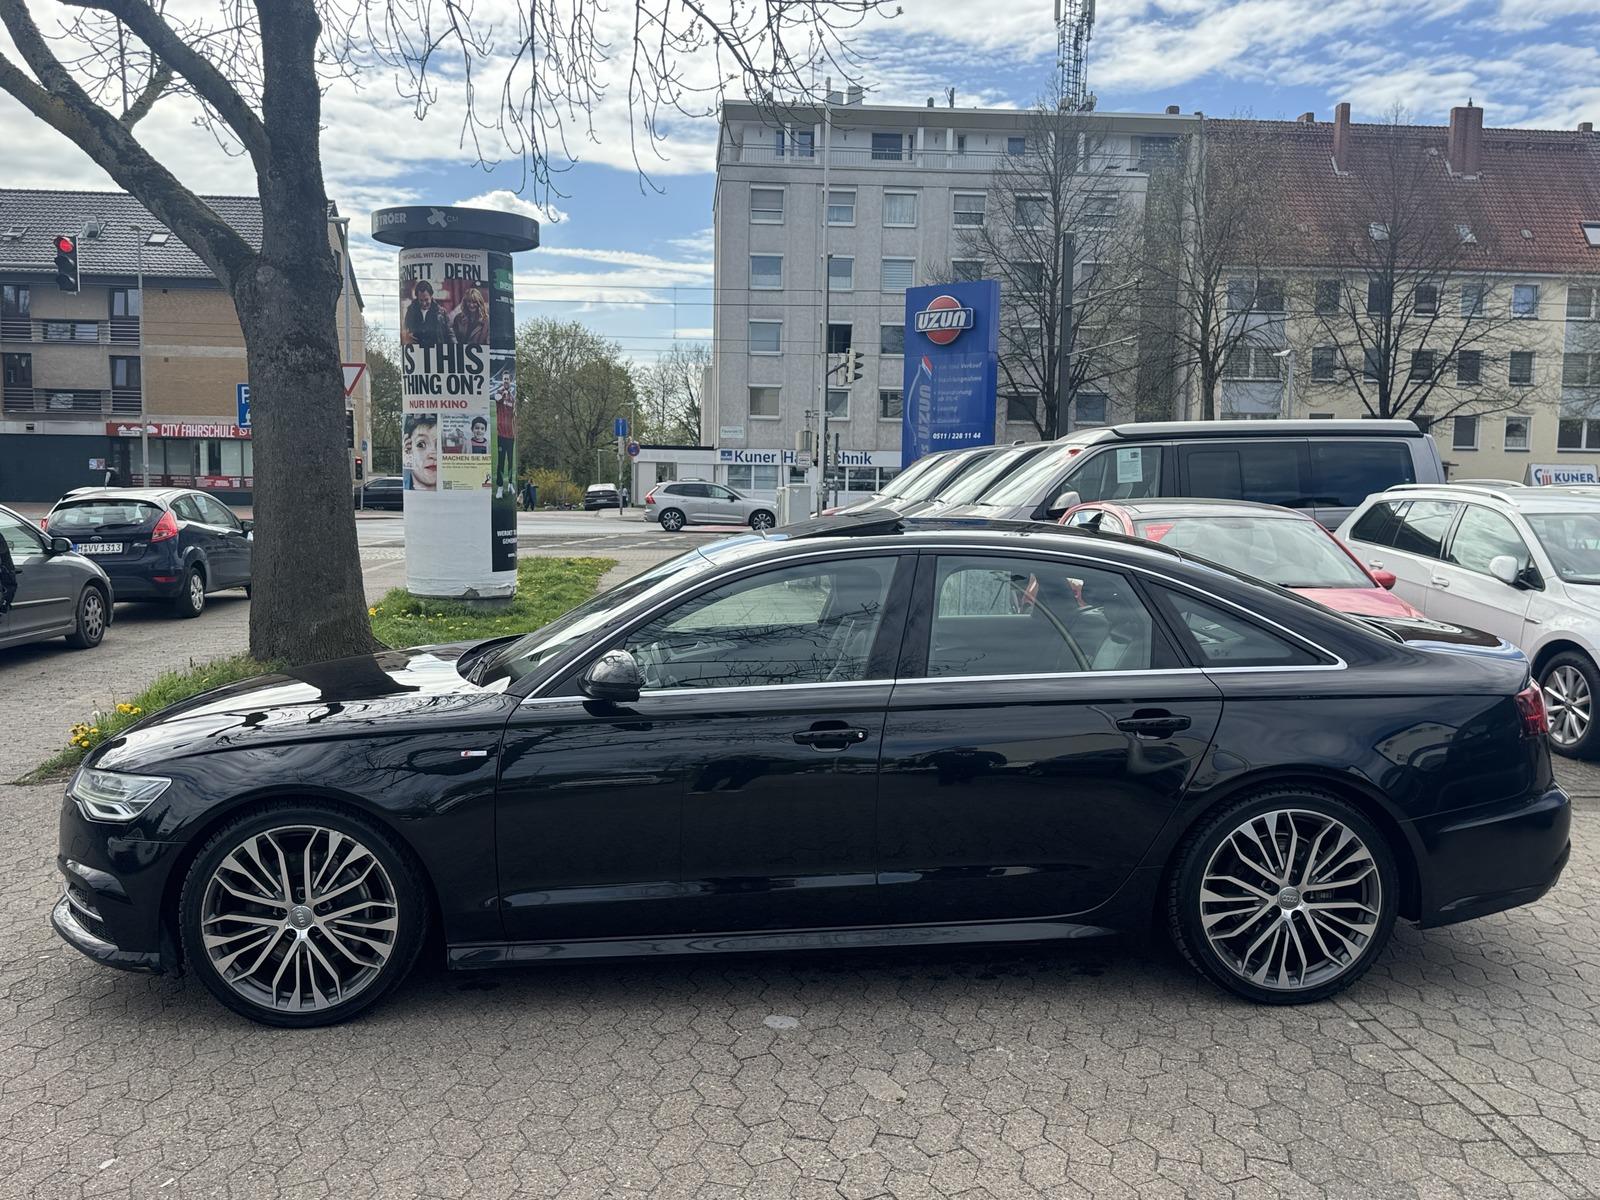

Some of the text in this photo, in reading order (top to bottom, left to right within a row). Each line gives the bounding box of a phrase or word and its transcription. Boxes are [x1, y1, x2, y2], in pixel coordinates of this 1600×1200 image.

[444, 263, 481, 281] DERN
[419, 343, 484, 375] THIS
[403, 374, 485, 396] THING ON?
[409, 400, 468, 409] NUR IM KINO
[161, 423, 235, 438] CITY FAHRSCHULE
[734, 450, 777, 463] Kuner
[1555, 473, 1595, 483] KUNER
[100, 543, 121, 552] 1313
